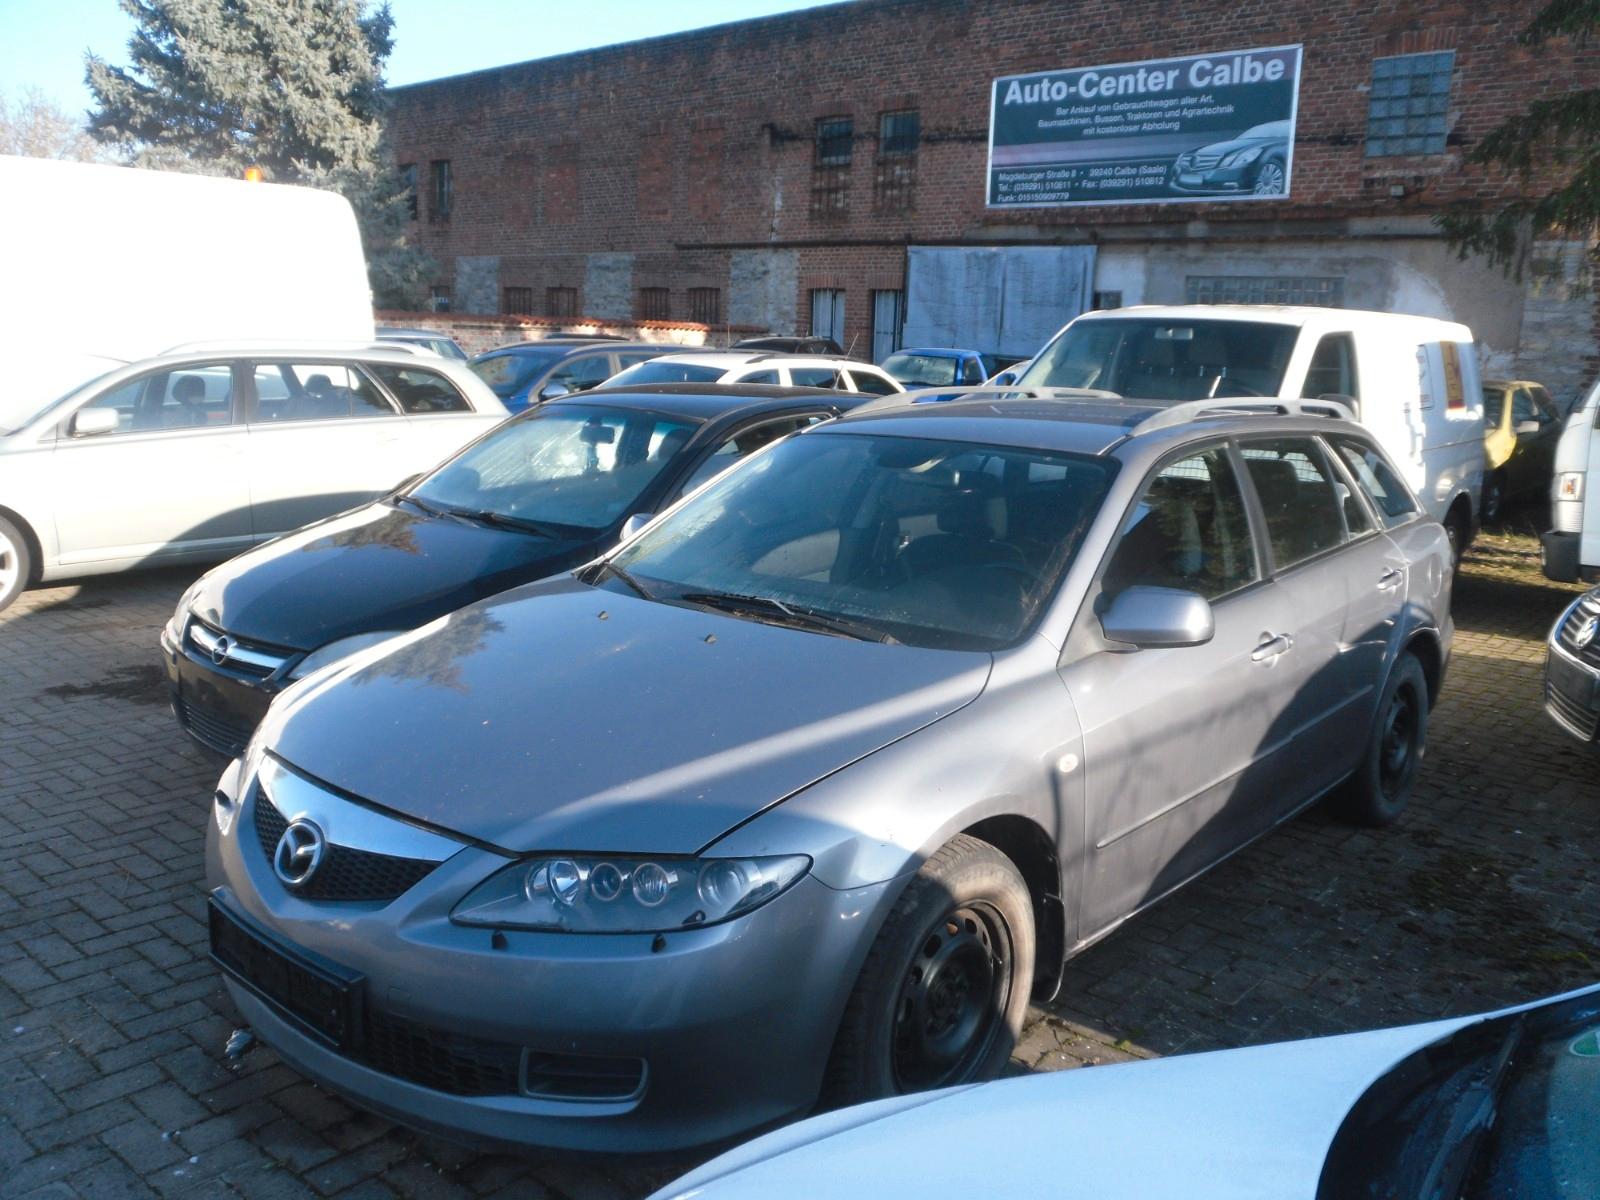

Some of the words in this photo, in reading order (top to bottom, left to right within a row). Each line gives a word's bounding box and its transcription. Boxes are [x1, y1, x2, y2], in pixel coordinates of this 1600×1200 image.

[1003, 67, 1180, 105] Auto-Center
[1188, 56, 1285, 87] Calbe
[1097, 104, 1111, 112] von
[1113, 98, 1178, 111] Gebrauchtwagen
[1126, 111, 1163, 121] Traktoren
[1164, 109, 1180, 118] und
[1182, 105, 1234, 118] Agrartechnik
[1083, 127, 1095, 136] mit
[1096, 124, 1140, 135] kostenloser
[1142, 121, 1180, 132] Abholung
[998, 172, 1045, 182] Magdeburger
[1114, 166, 1137, 175] Calbe
